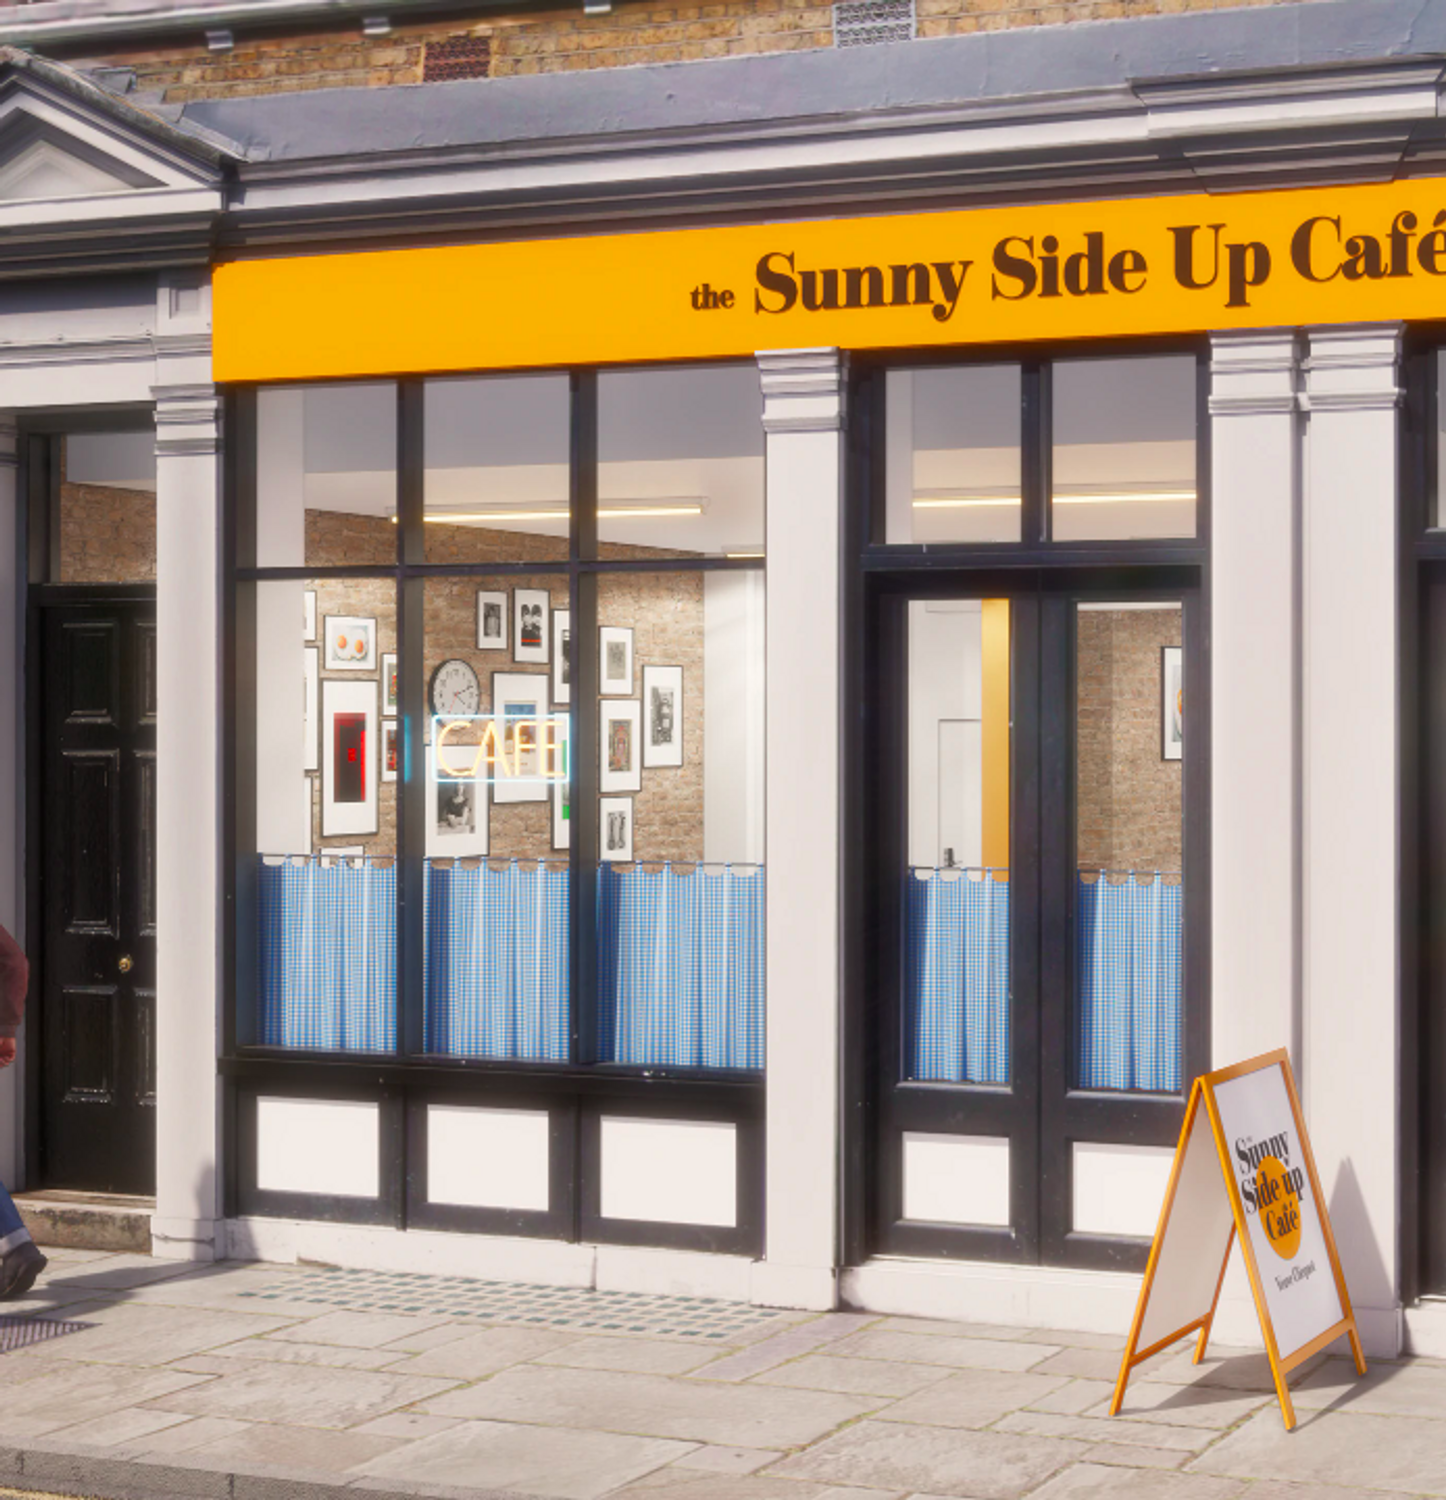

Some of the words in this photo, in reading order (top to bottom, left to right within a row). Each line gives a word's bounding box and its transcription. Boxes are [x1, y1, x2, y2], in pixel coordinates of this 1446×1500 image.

[690, 283, 735, 310] the
[755, 252, 973, 322] Sunny
[991, 231, 1147, 300] Side
[1166, 223, 1271, 308] Up
[437, 720, 566, 778] CAFE
[1235, 1131, 1290, 1175] Sunny
[1241, 1171, 1280, 1215] Side
[1281, 1166, 1304, 1201] up
[1266, 1201, 1299, 1240] Café
